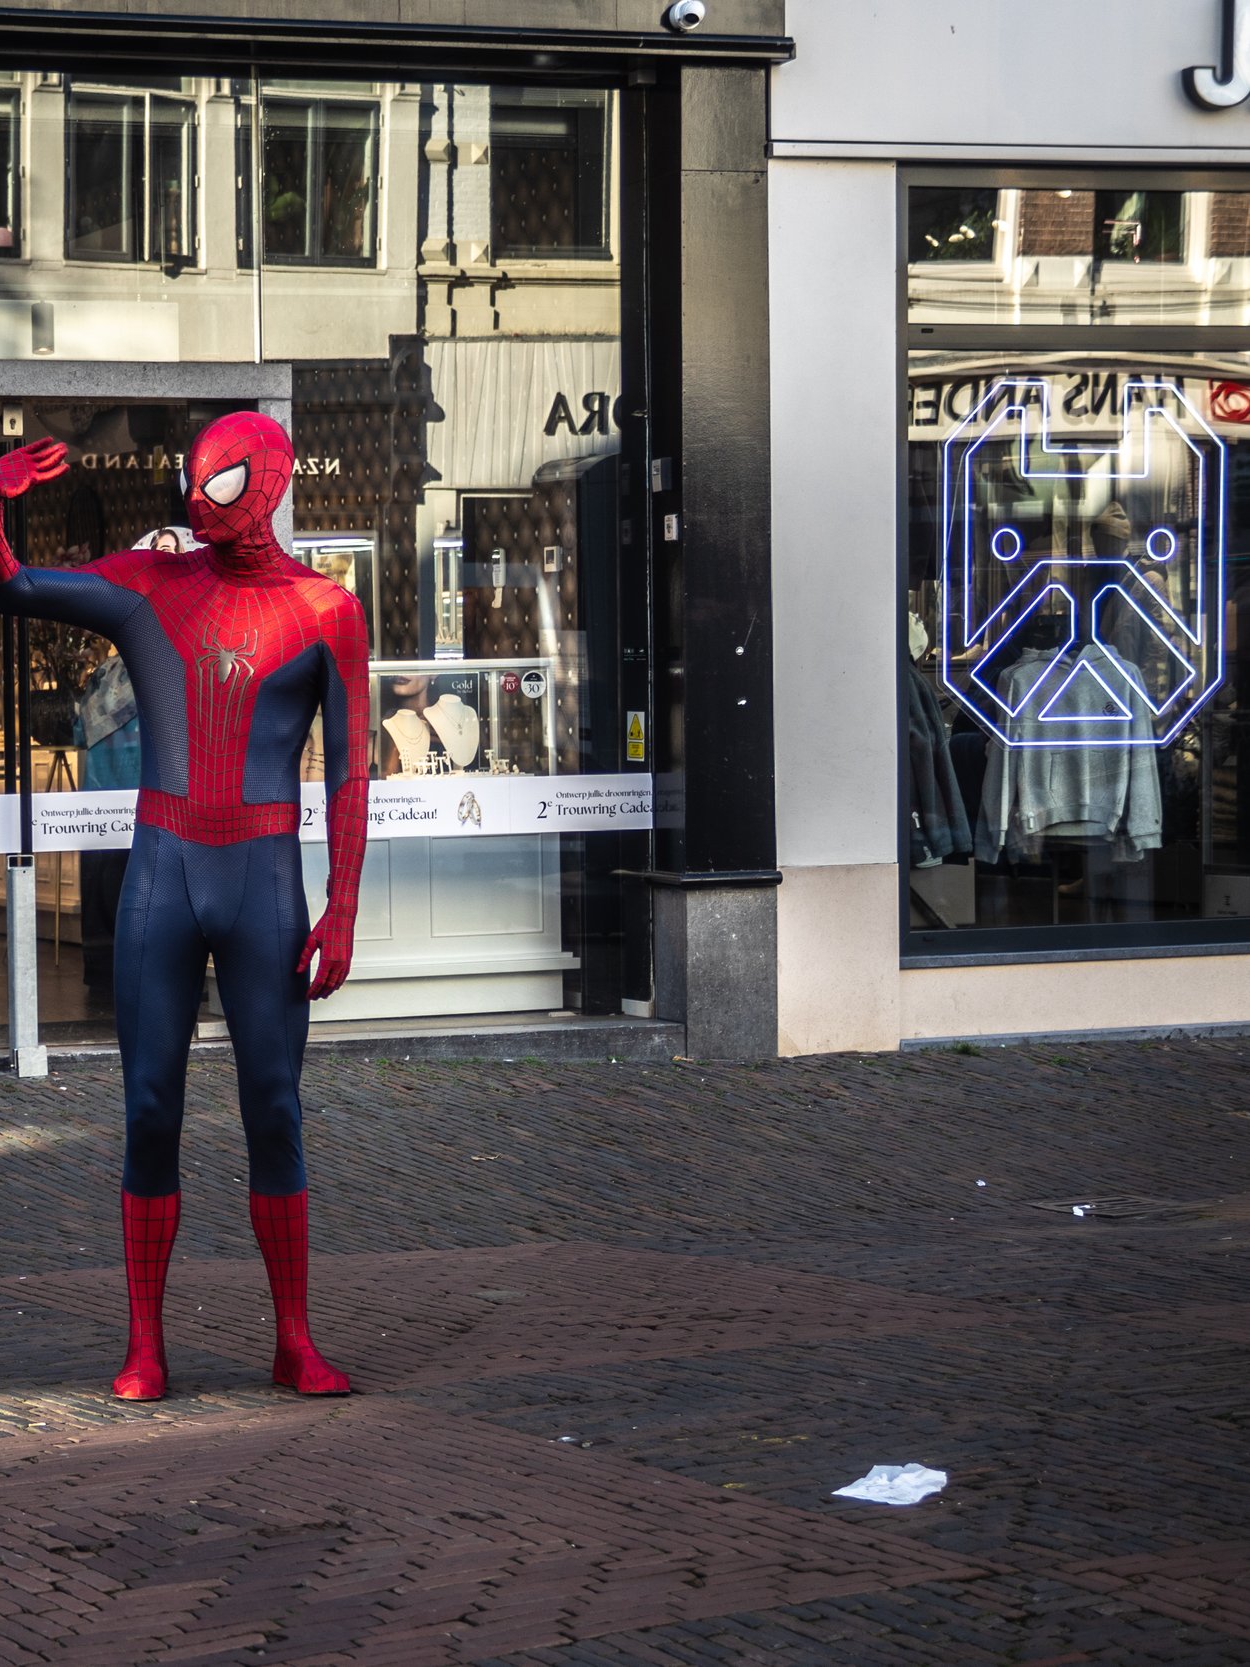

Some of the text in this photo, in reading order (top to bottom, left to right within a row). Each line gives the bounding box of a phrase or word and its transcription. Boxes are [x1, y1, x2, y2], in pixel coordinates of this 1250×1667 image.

[451, 679, 473, 690] Gold
[556, 791, 587, 800] Ontwerp
[588, 790, 604, 800] jullie
[41, 809, 75, 818] Ontwerp
[75, 808, 94, 818] jullie
[388, 807, 438, 821] Cadeau!
[556, 803, 617, 817] Trouwring
[41, 822, 108, 836] Trouwring
